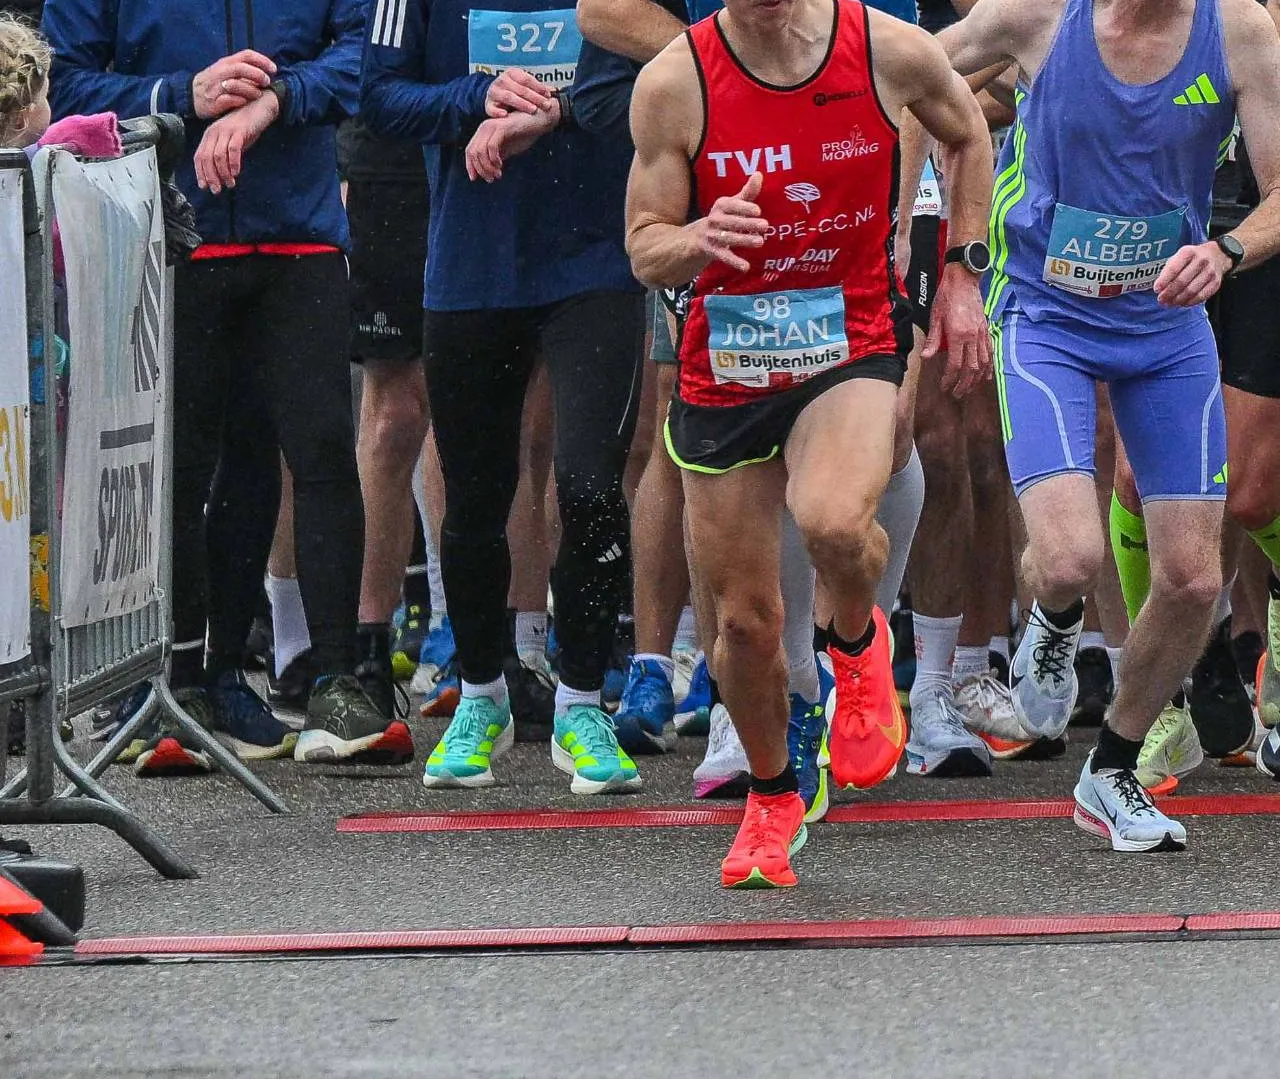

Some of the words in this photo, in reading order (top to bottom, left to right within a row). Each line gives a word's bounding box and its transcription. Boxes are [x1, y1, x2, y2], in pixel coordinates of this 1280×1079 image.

[497, 21, 565, 52] 327
[822, 140, 851, 152] PRO
[822, 142, 880, 162] MOVING
[708, 144, 793, 178] TVH
[1094, 217, 1149, 240] 279
[1060, 237, 1170, 262] ALBERT
[1073, 262, 1167, 285] Buijtenhuis
[918, 271, 929, 307] FUSION
[753, 295, 792, 321] 98
[721, 317, 830, 347] JOHAN
[738, 348, 841, 371] Buijtenhuis
